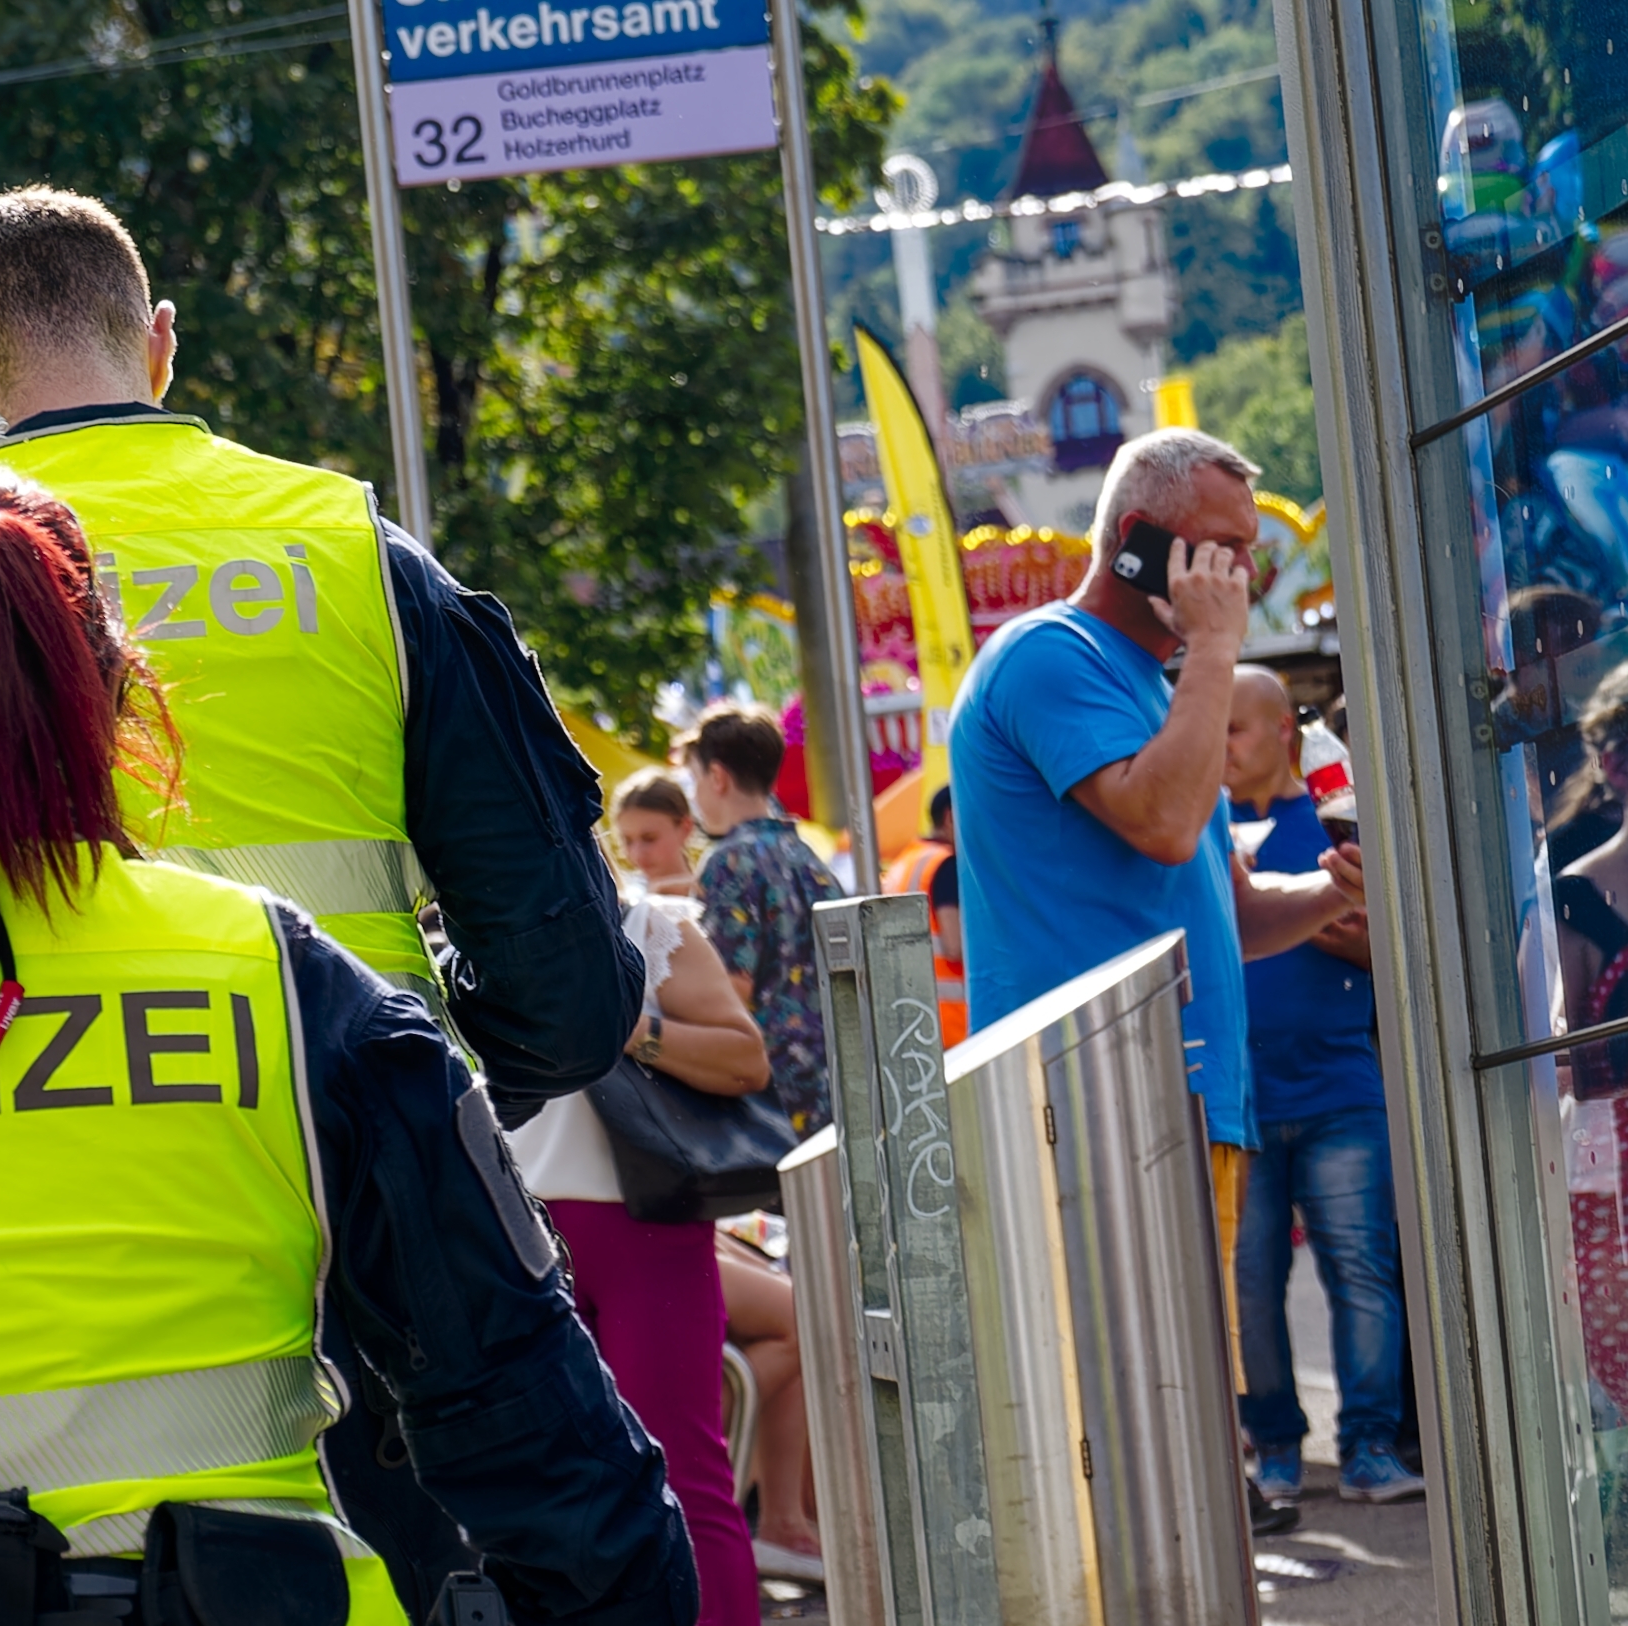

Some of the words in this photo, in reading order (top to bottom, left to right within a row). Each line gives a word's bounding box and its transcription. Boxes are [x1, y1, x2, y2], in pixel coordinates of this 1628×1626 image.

[396, 0, 721, 60] verkehrsamt
[497, 63, 706, 103] Goldbrunnenplatz
[500, 98, 663, 133] Bucheggplatz
[413, 115, 487, 168] 32
[503, 128, 632, 161] Holzerhurd
[93, 543, 320, 641] izei
